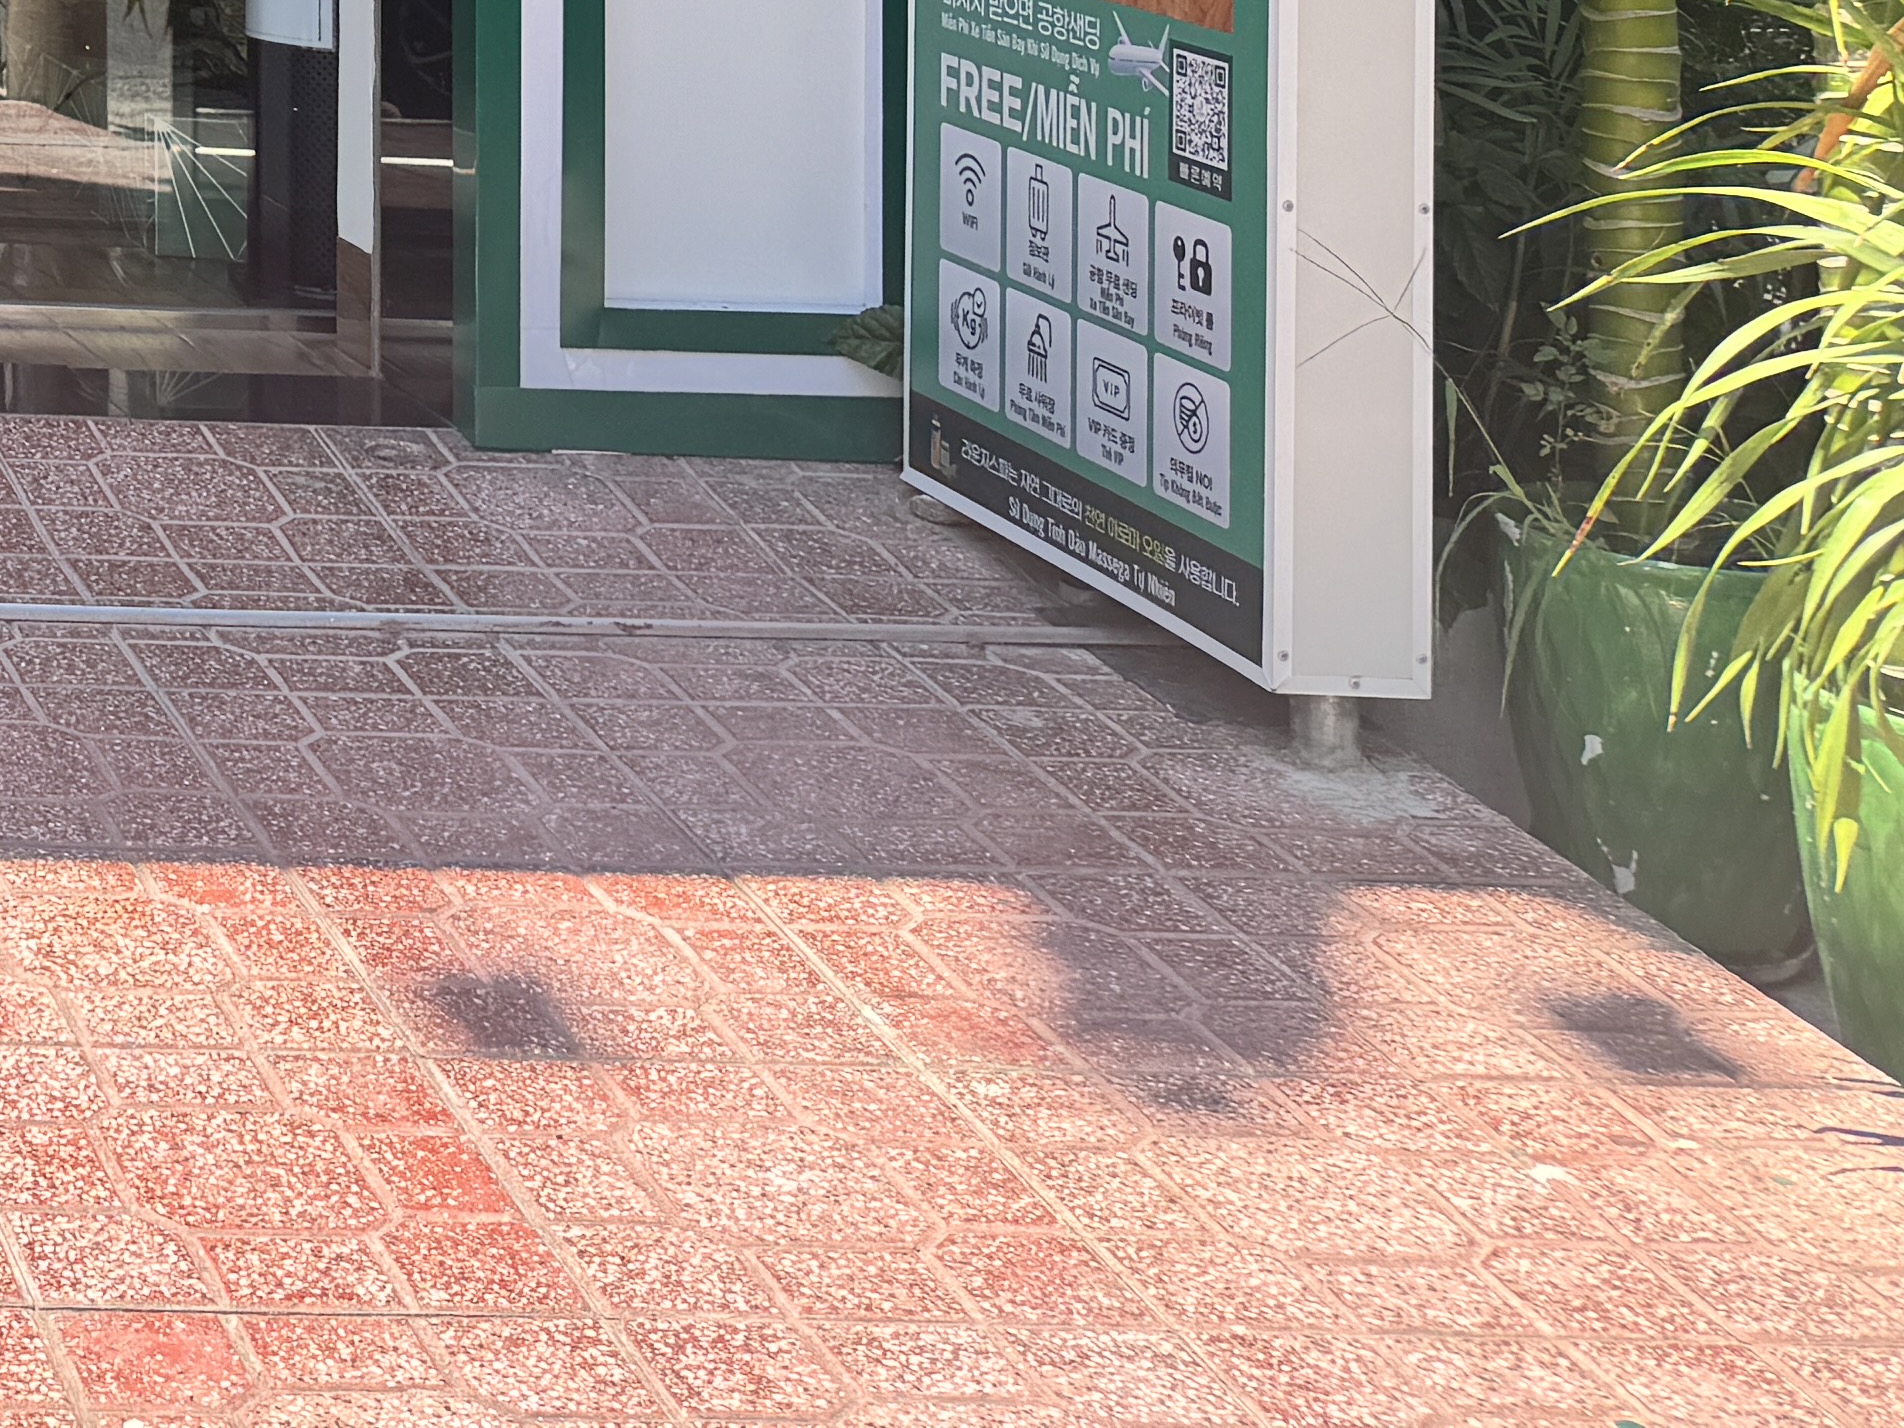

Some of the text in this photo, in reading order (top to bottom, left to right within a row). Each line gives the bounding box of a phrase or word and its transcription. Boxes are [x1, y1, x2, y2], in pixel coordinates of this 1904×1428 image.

[1037, 0, 1101, 51] 공항샌딩
[1106, 106, 1150, 180] PHÍ
[1103, 379, 1120, 398] VIP
[1020, 468, 1041, 498] 자연
[1042, 480, 1083, 522] 그대로의
[1084, 504, 1106, 534] 천연
[1178, 554, 1240, 607] 사용합니다.
